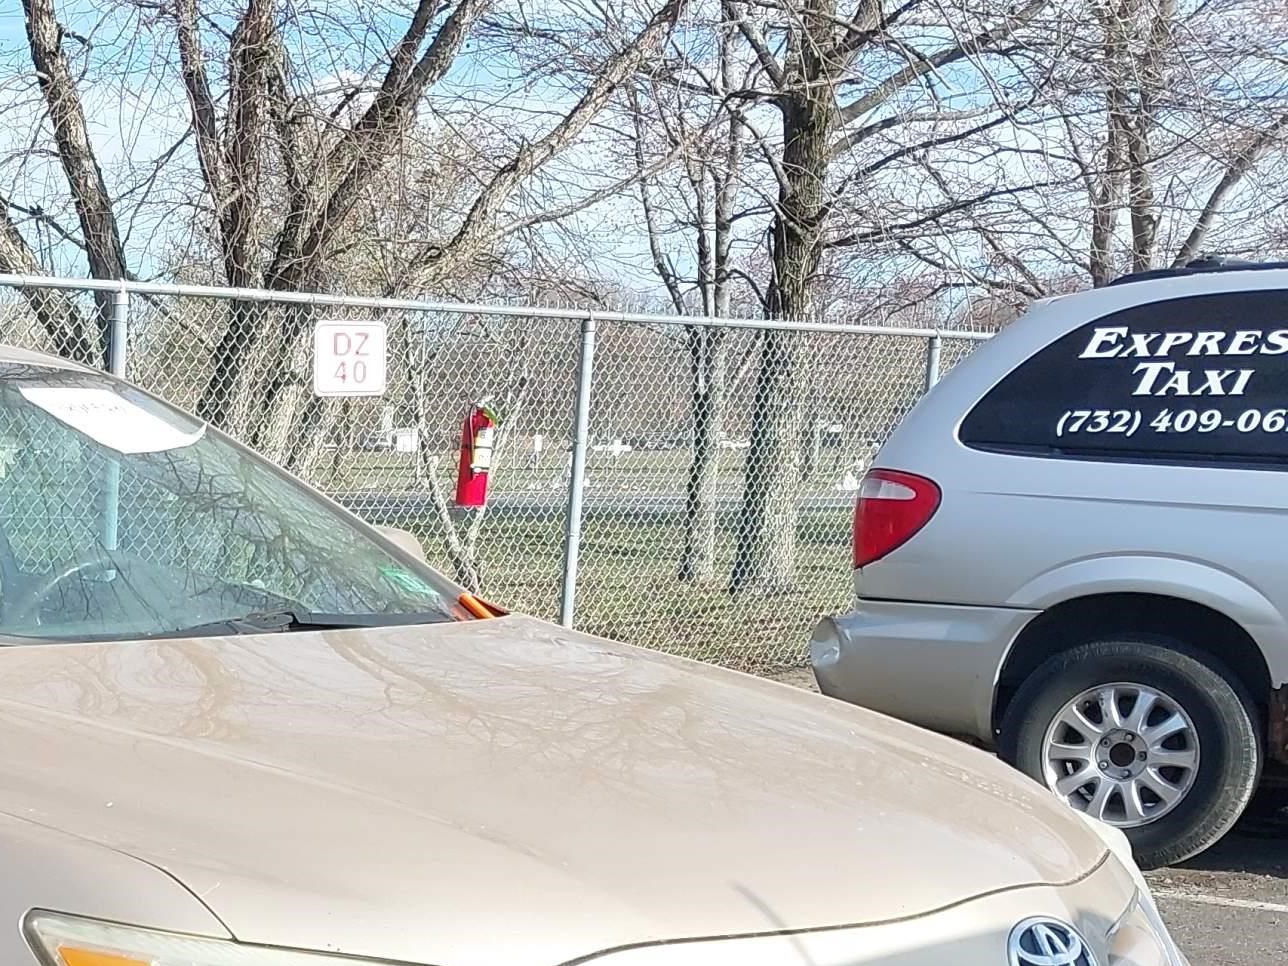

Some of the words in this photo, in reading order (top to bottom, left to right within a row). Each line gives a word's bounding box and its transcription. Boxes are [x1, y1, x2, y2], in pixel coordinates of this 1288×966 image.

[333, 332, 370, 356] DZ
[333, 360, 367, 384] 40
[1131, 362, 1256, 396] TAXI
[1056, 410, 1142, 437] (732)
[1149, 408, 1288, 433] 409-06
